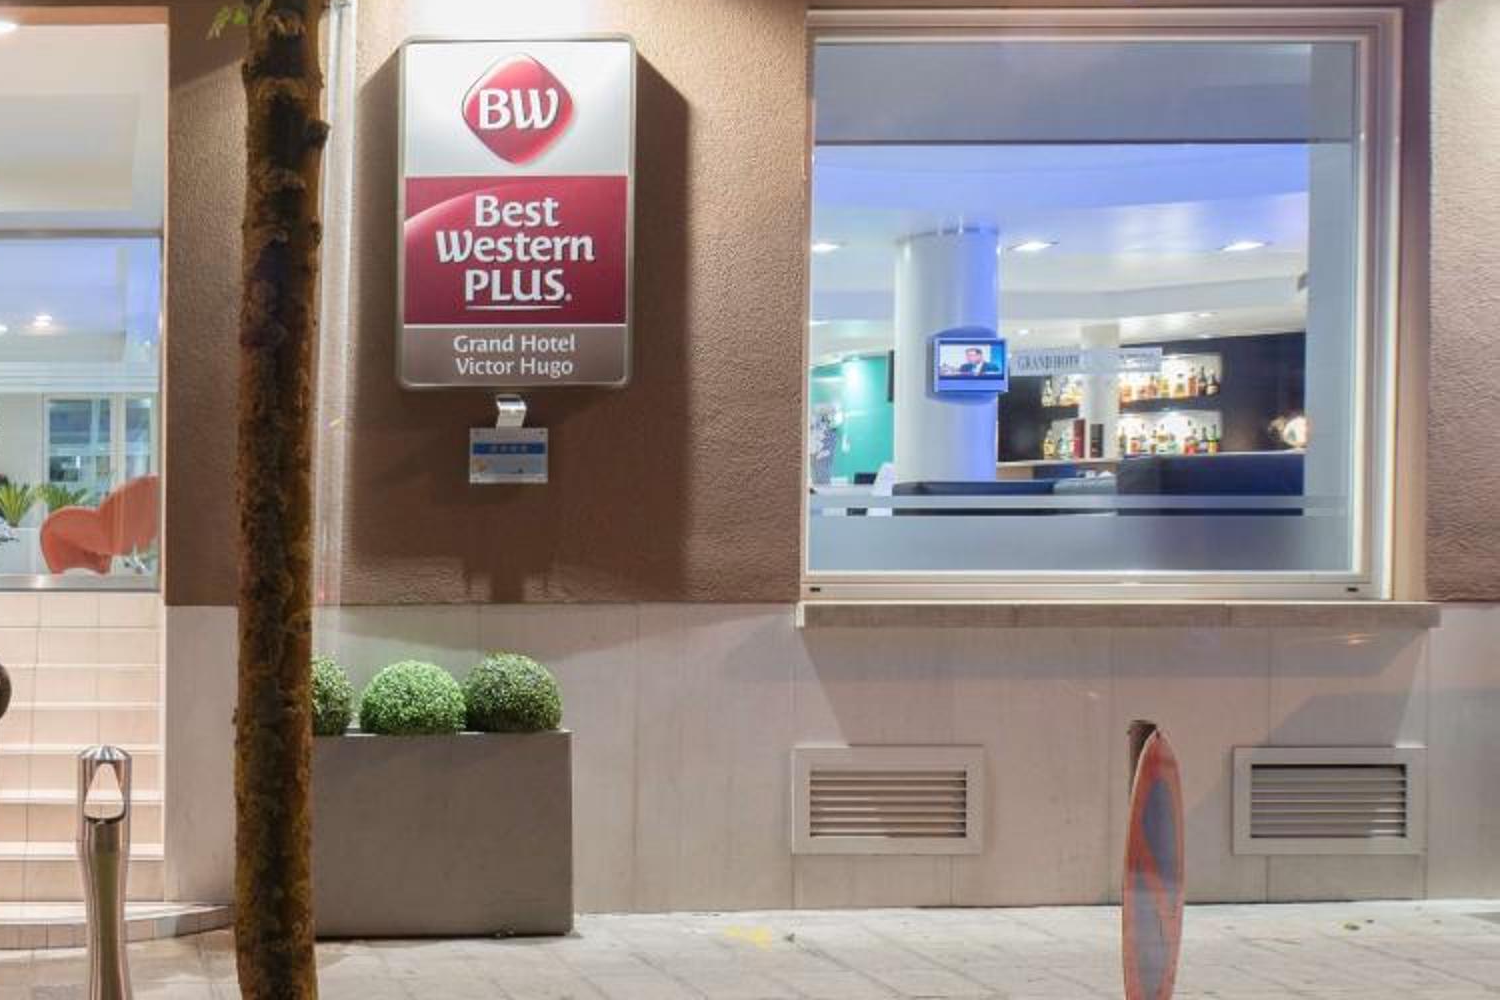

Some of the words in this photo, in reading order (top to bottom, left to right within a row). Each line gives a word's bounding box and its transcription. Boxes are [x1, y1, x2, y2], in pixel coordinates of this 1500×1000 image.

[478, 87, 560, 131] BW
[474, 194, 560, 228] Best
[434, 229, 596, 264] Western
[452, 332, 515, 353] Grand
[520, 332, 576, 353] Hotel
[455, 356, 516, 376] Victor
[520, 356, 574, 380] Hugo
